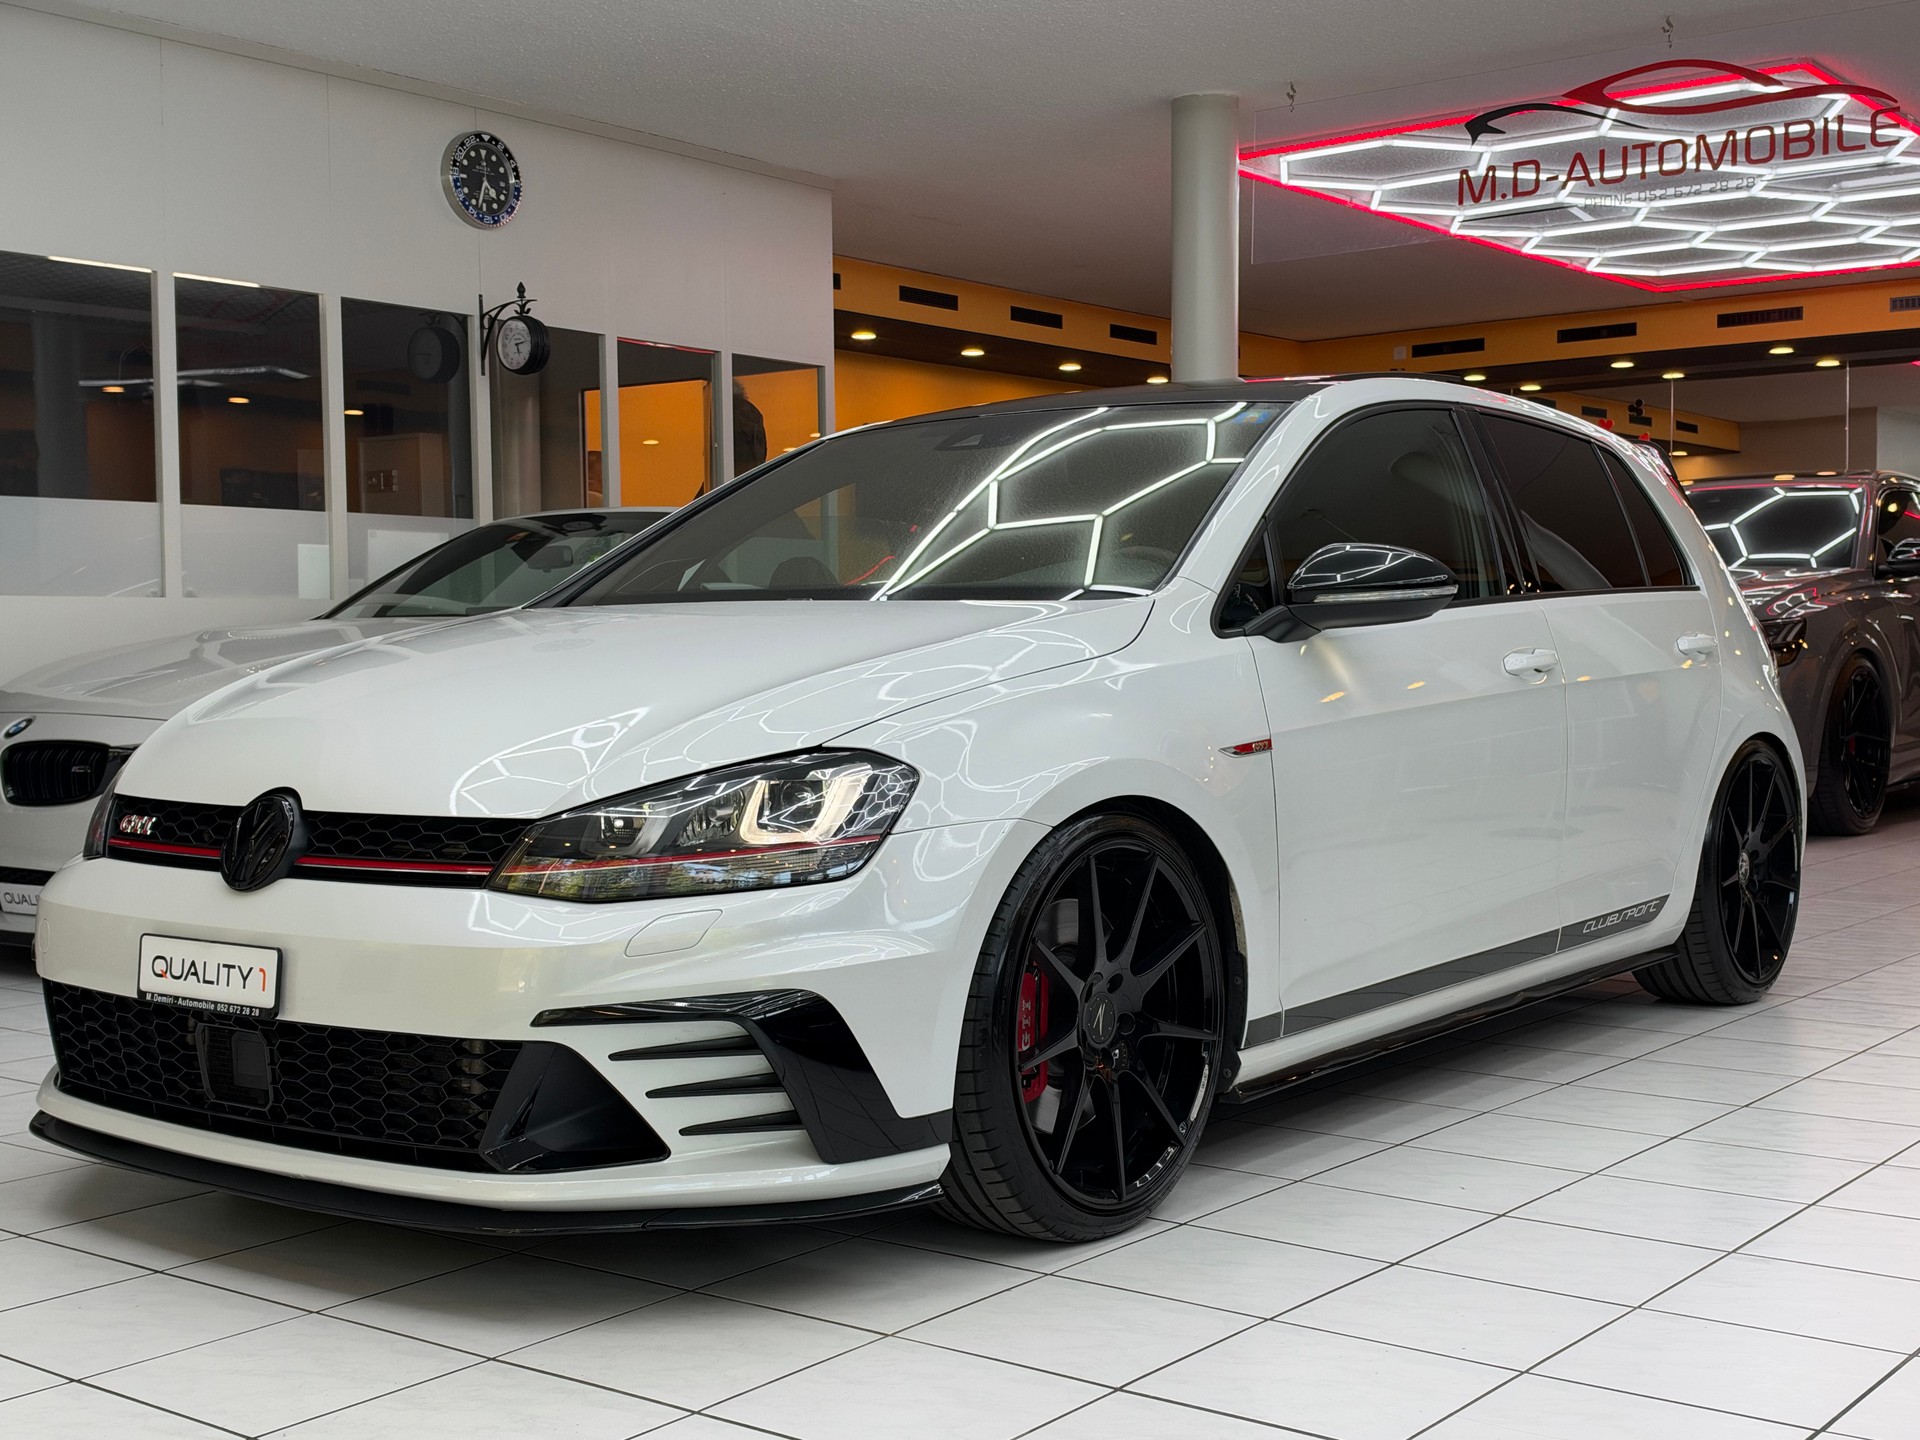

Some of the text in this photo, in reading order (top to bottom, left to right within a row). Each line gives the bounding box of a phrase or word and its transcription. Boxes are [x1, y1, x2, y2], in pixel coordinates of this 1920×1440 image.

[464, 135, 477, 147] 22
[1457, 106, 1900, 206] M.D-AUTOMOBILE
[1638, 188, 1667, 203] 052
[1709, 180, 1729, 194] 28
[1736, 177, 1756, 190] 28
[3, 891, 40, 906] QUALI
[151, 954, 267, 993] QUALITY 1
[177, 997, 215, 1011] Automobile
[216, 1004, 228, 1013] 052
[229, 1006, 241, 1014] 672
[242, 1007, 250, 1016] 28
[251, 1009, 260, 1017] 28
